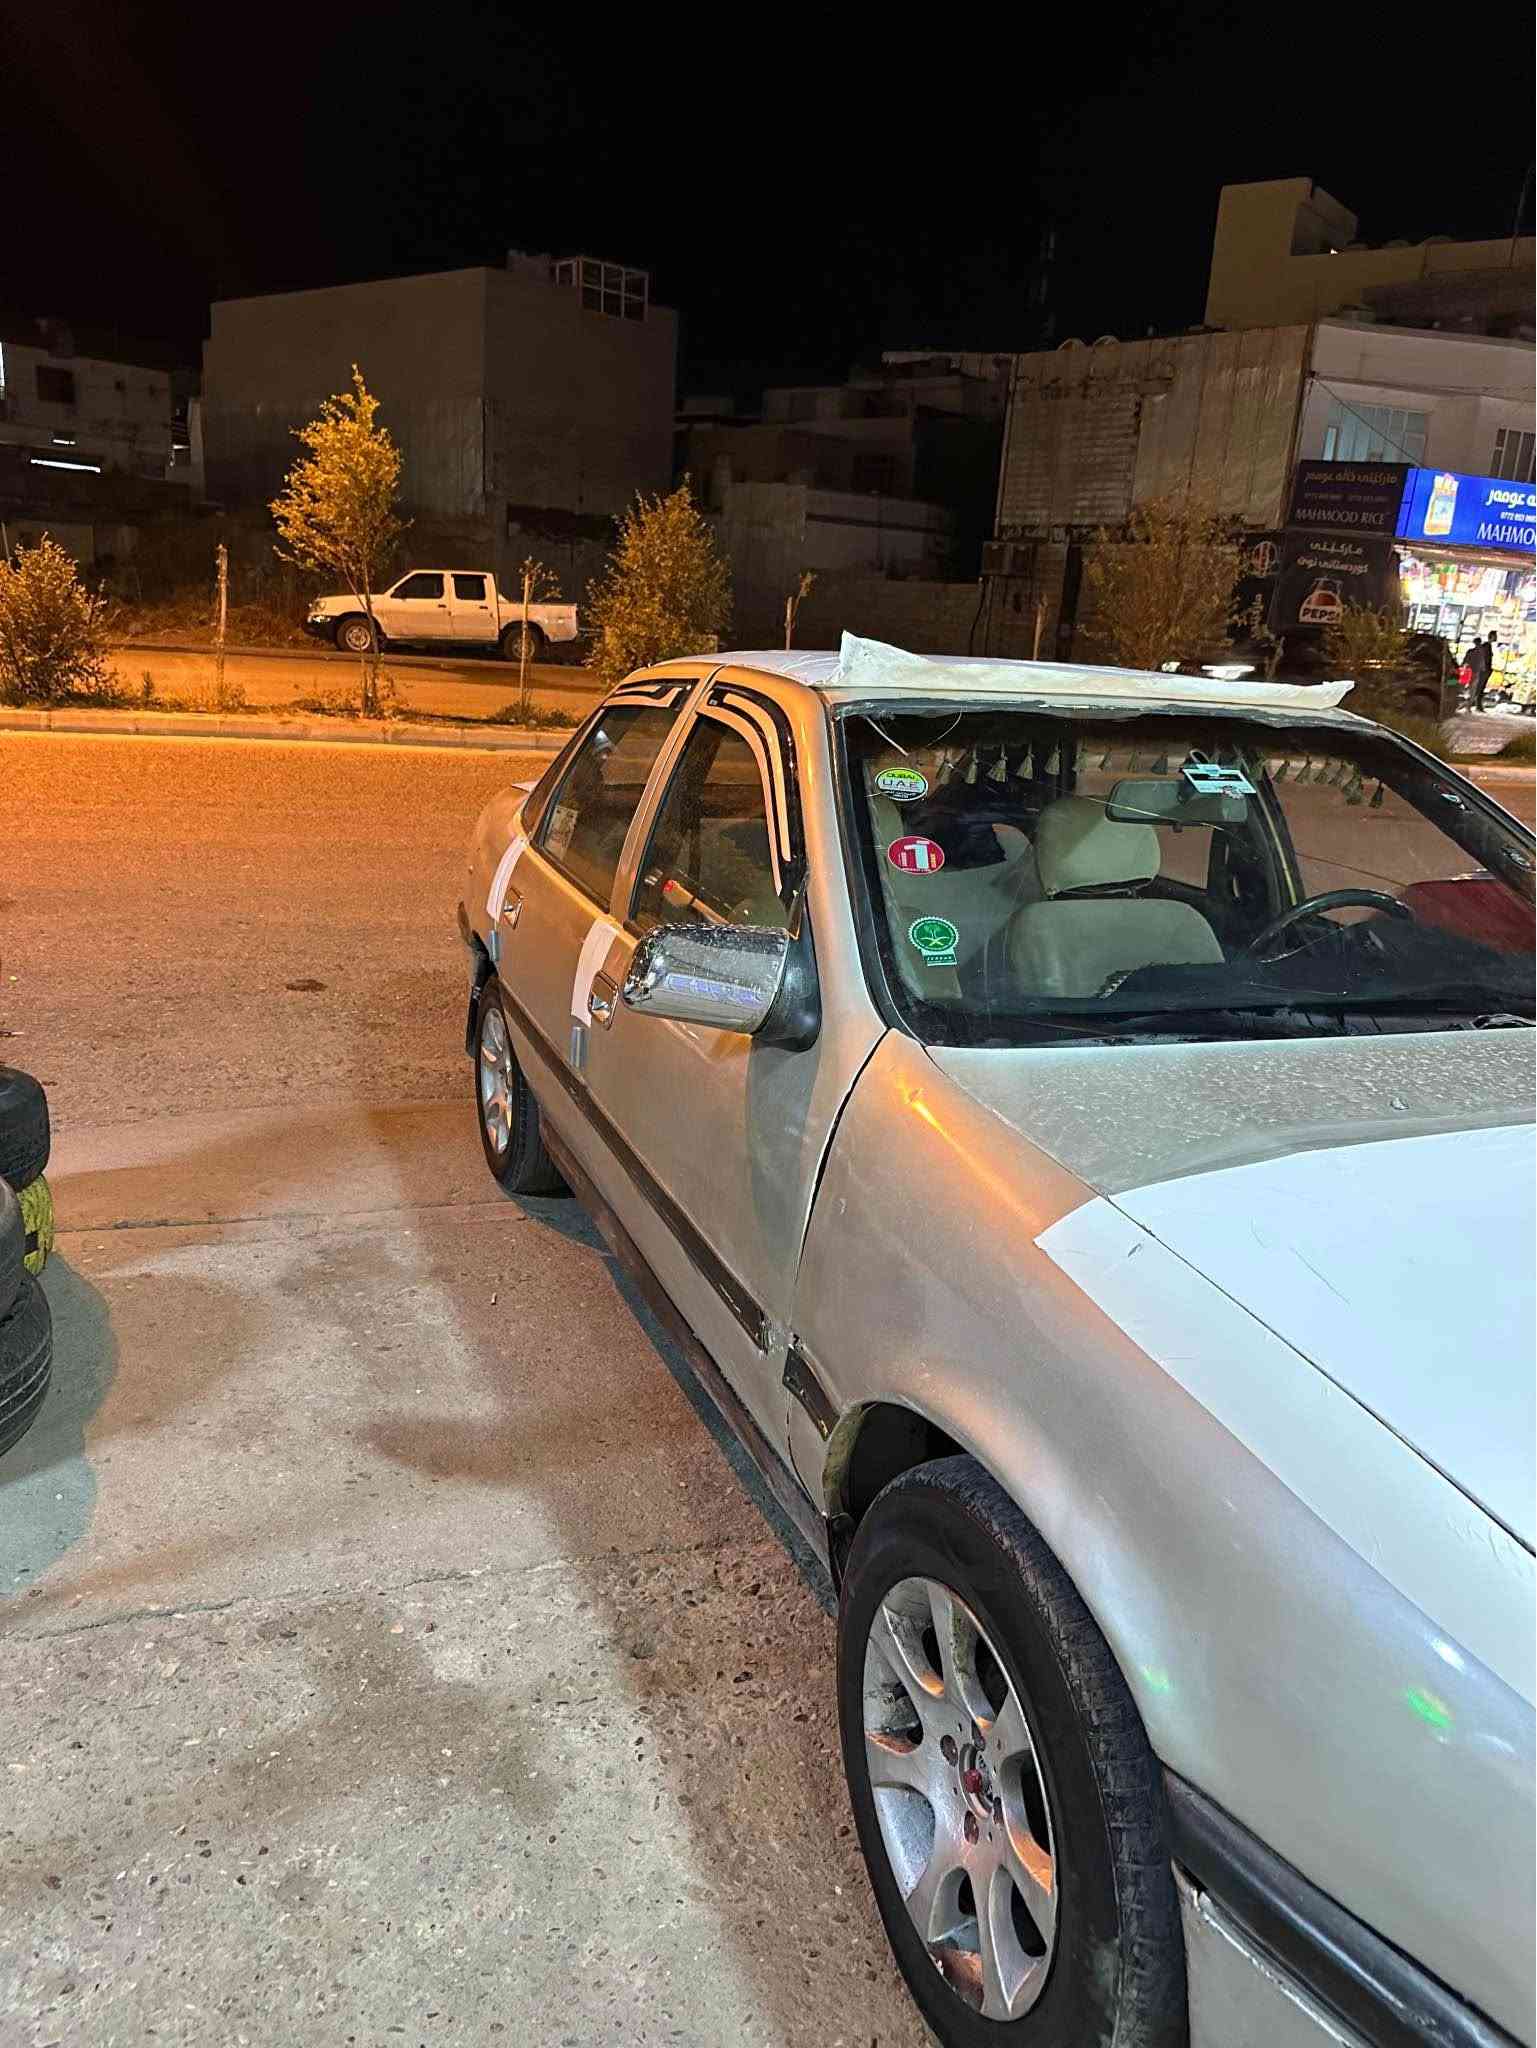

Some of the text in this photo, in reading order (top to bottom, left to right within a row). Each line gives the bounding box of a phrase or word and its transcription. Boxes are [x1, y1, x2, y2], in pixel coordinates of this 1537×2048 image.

[1295, 508, 1386, 525] MAHMOOD RICE
[1476, 522, 1537, 545] MAHMO
[881, 778, 921, 791] UAE
